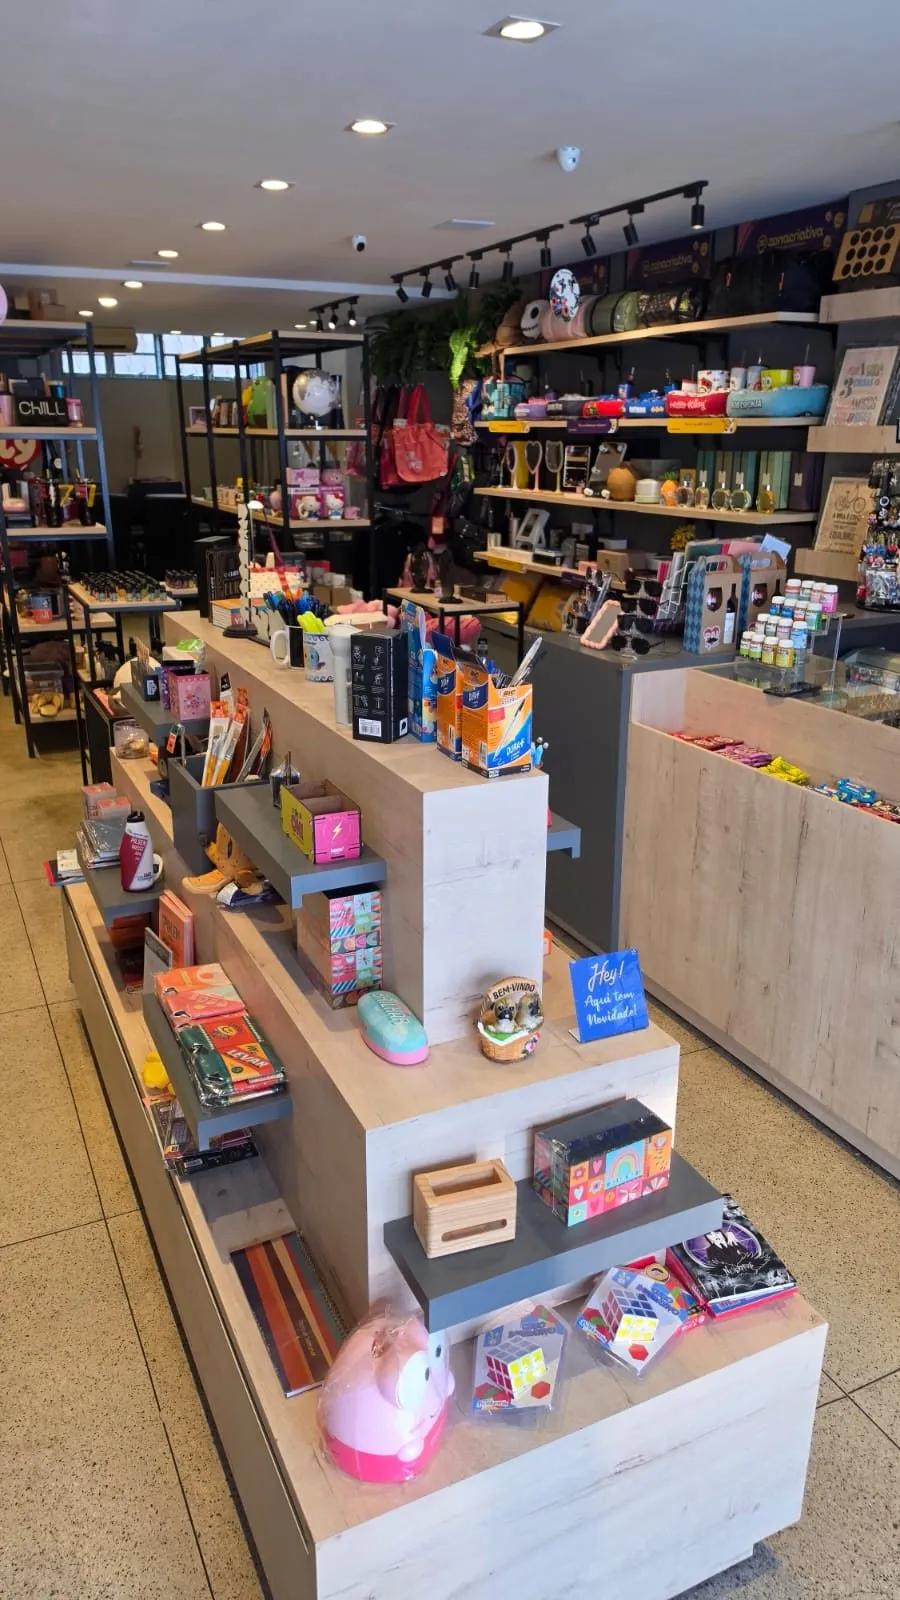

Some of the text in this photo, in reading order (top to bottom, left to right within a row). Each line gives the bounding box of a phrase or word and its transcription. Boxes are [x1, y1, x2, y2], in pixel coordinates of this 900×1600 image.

[587, 959, 625, 993] Hey!
[492, 982, 536, 1000] BEM-VINDO
[584, 990, 636, 1013] Aqui tem
[586, 1003, 638, 1027] Novidade!
